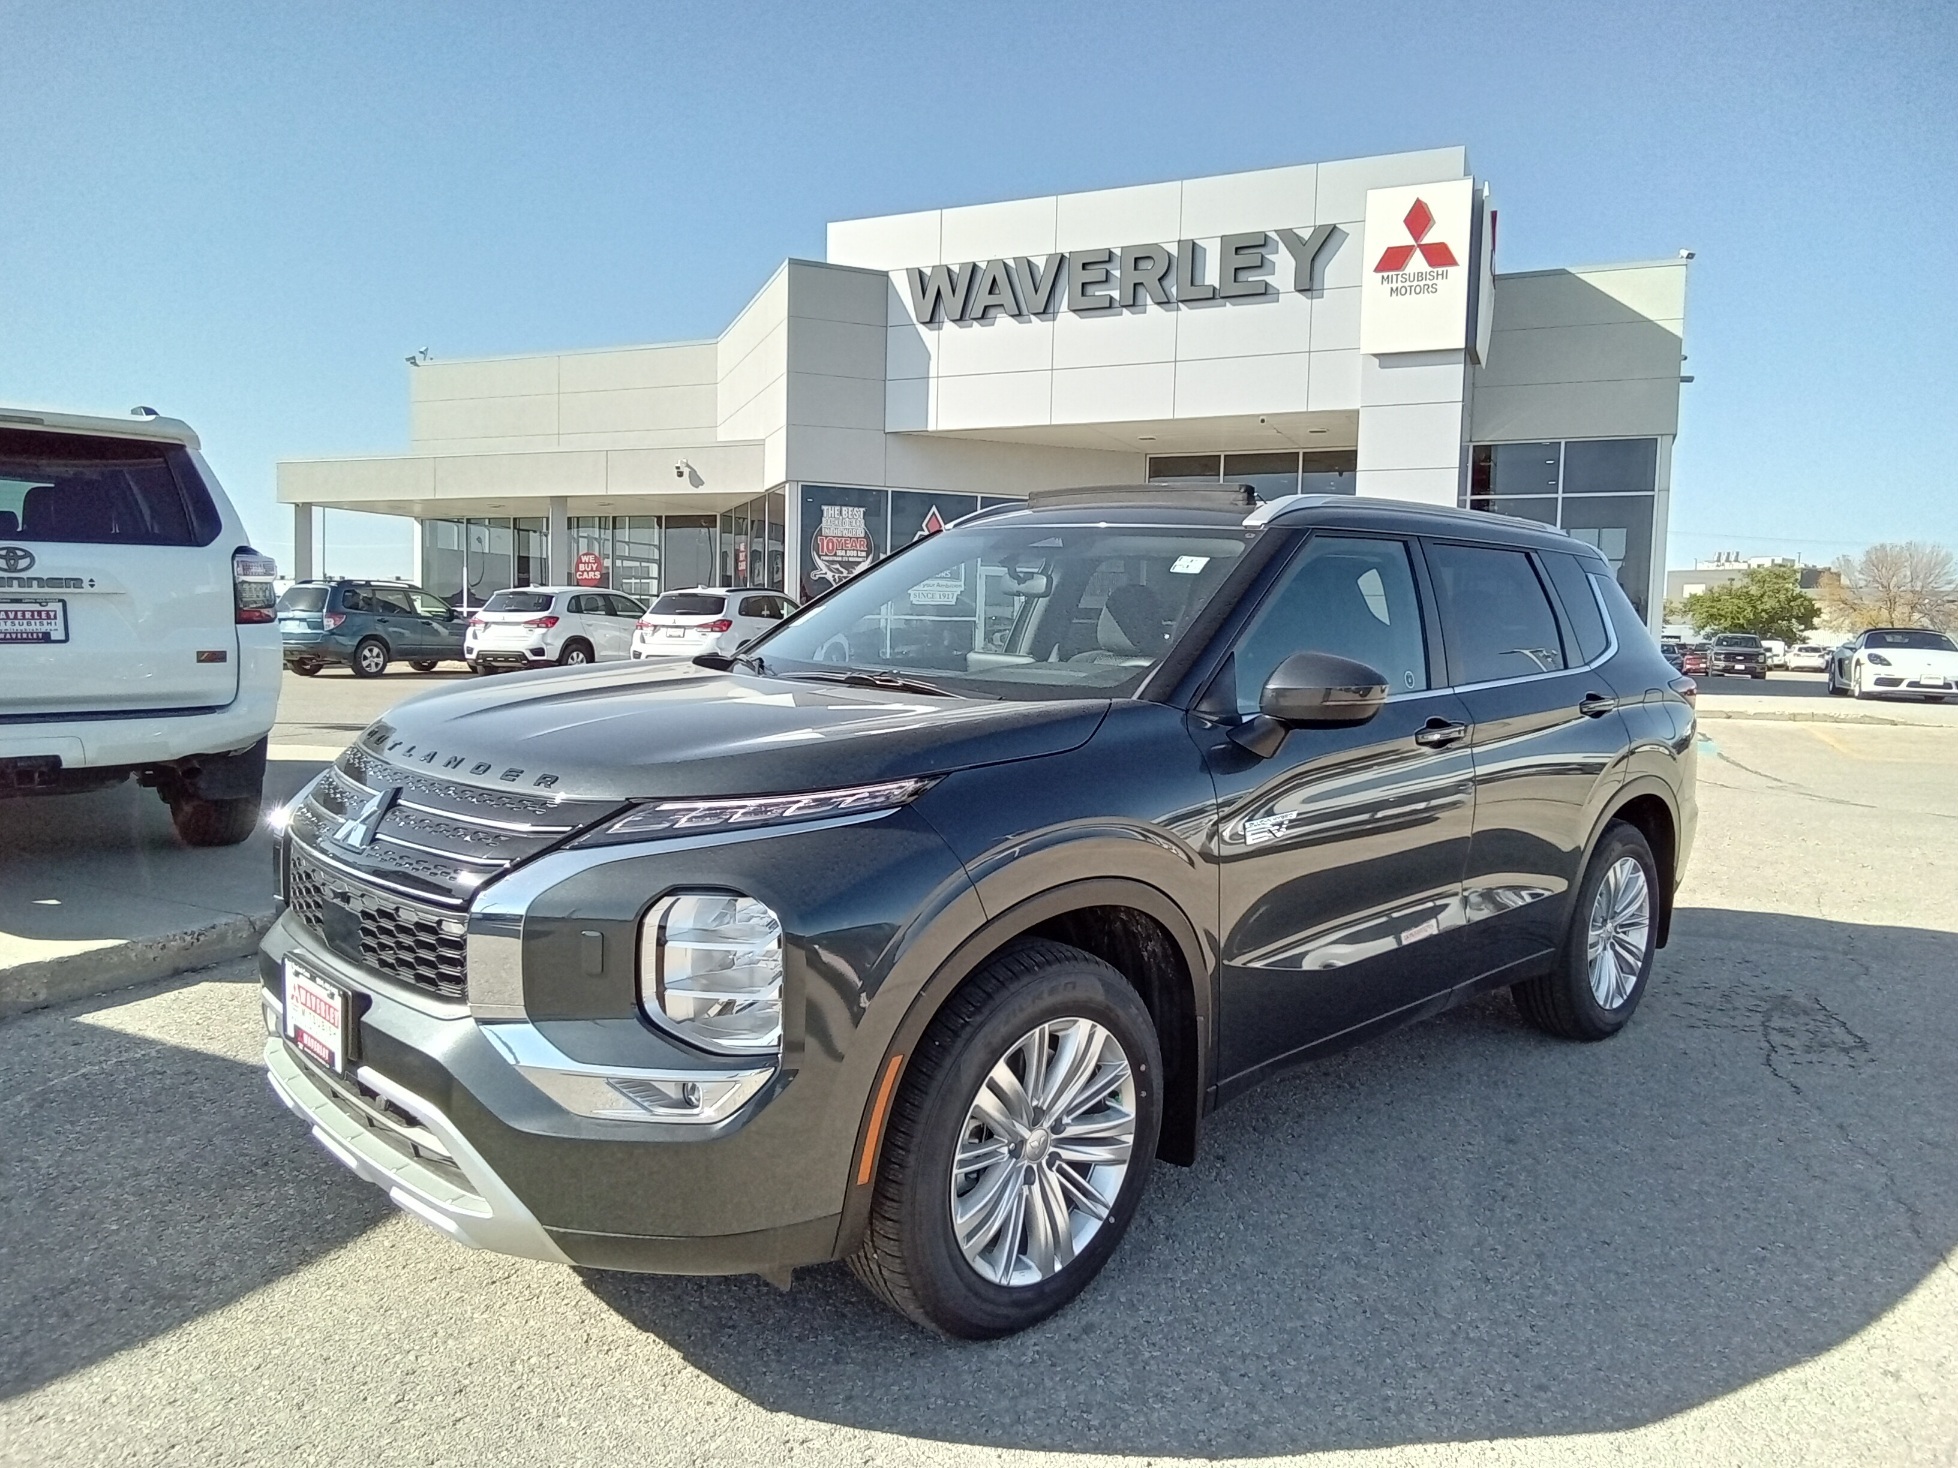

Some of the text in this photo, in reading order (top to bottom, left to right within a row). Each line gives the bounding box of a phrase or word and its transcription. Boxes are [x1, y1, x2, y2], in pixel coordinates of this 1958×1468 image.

[907, 223, 1337, 324] WAVERLEY
[1381, 269, 1449, 285] MITSUBISHI
[1389, 283, 1438, 297] MOTORS
[821, 505, 867, 519] THE BEST
[818, 536, 867, 556] 10 YEAR
[580, 555, 595, 563] WE
[576, 571, 601, 579] CARS
[913, 591, 936, 599] SINCE
[367, 729, 559, 788] OUTLANDER
